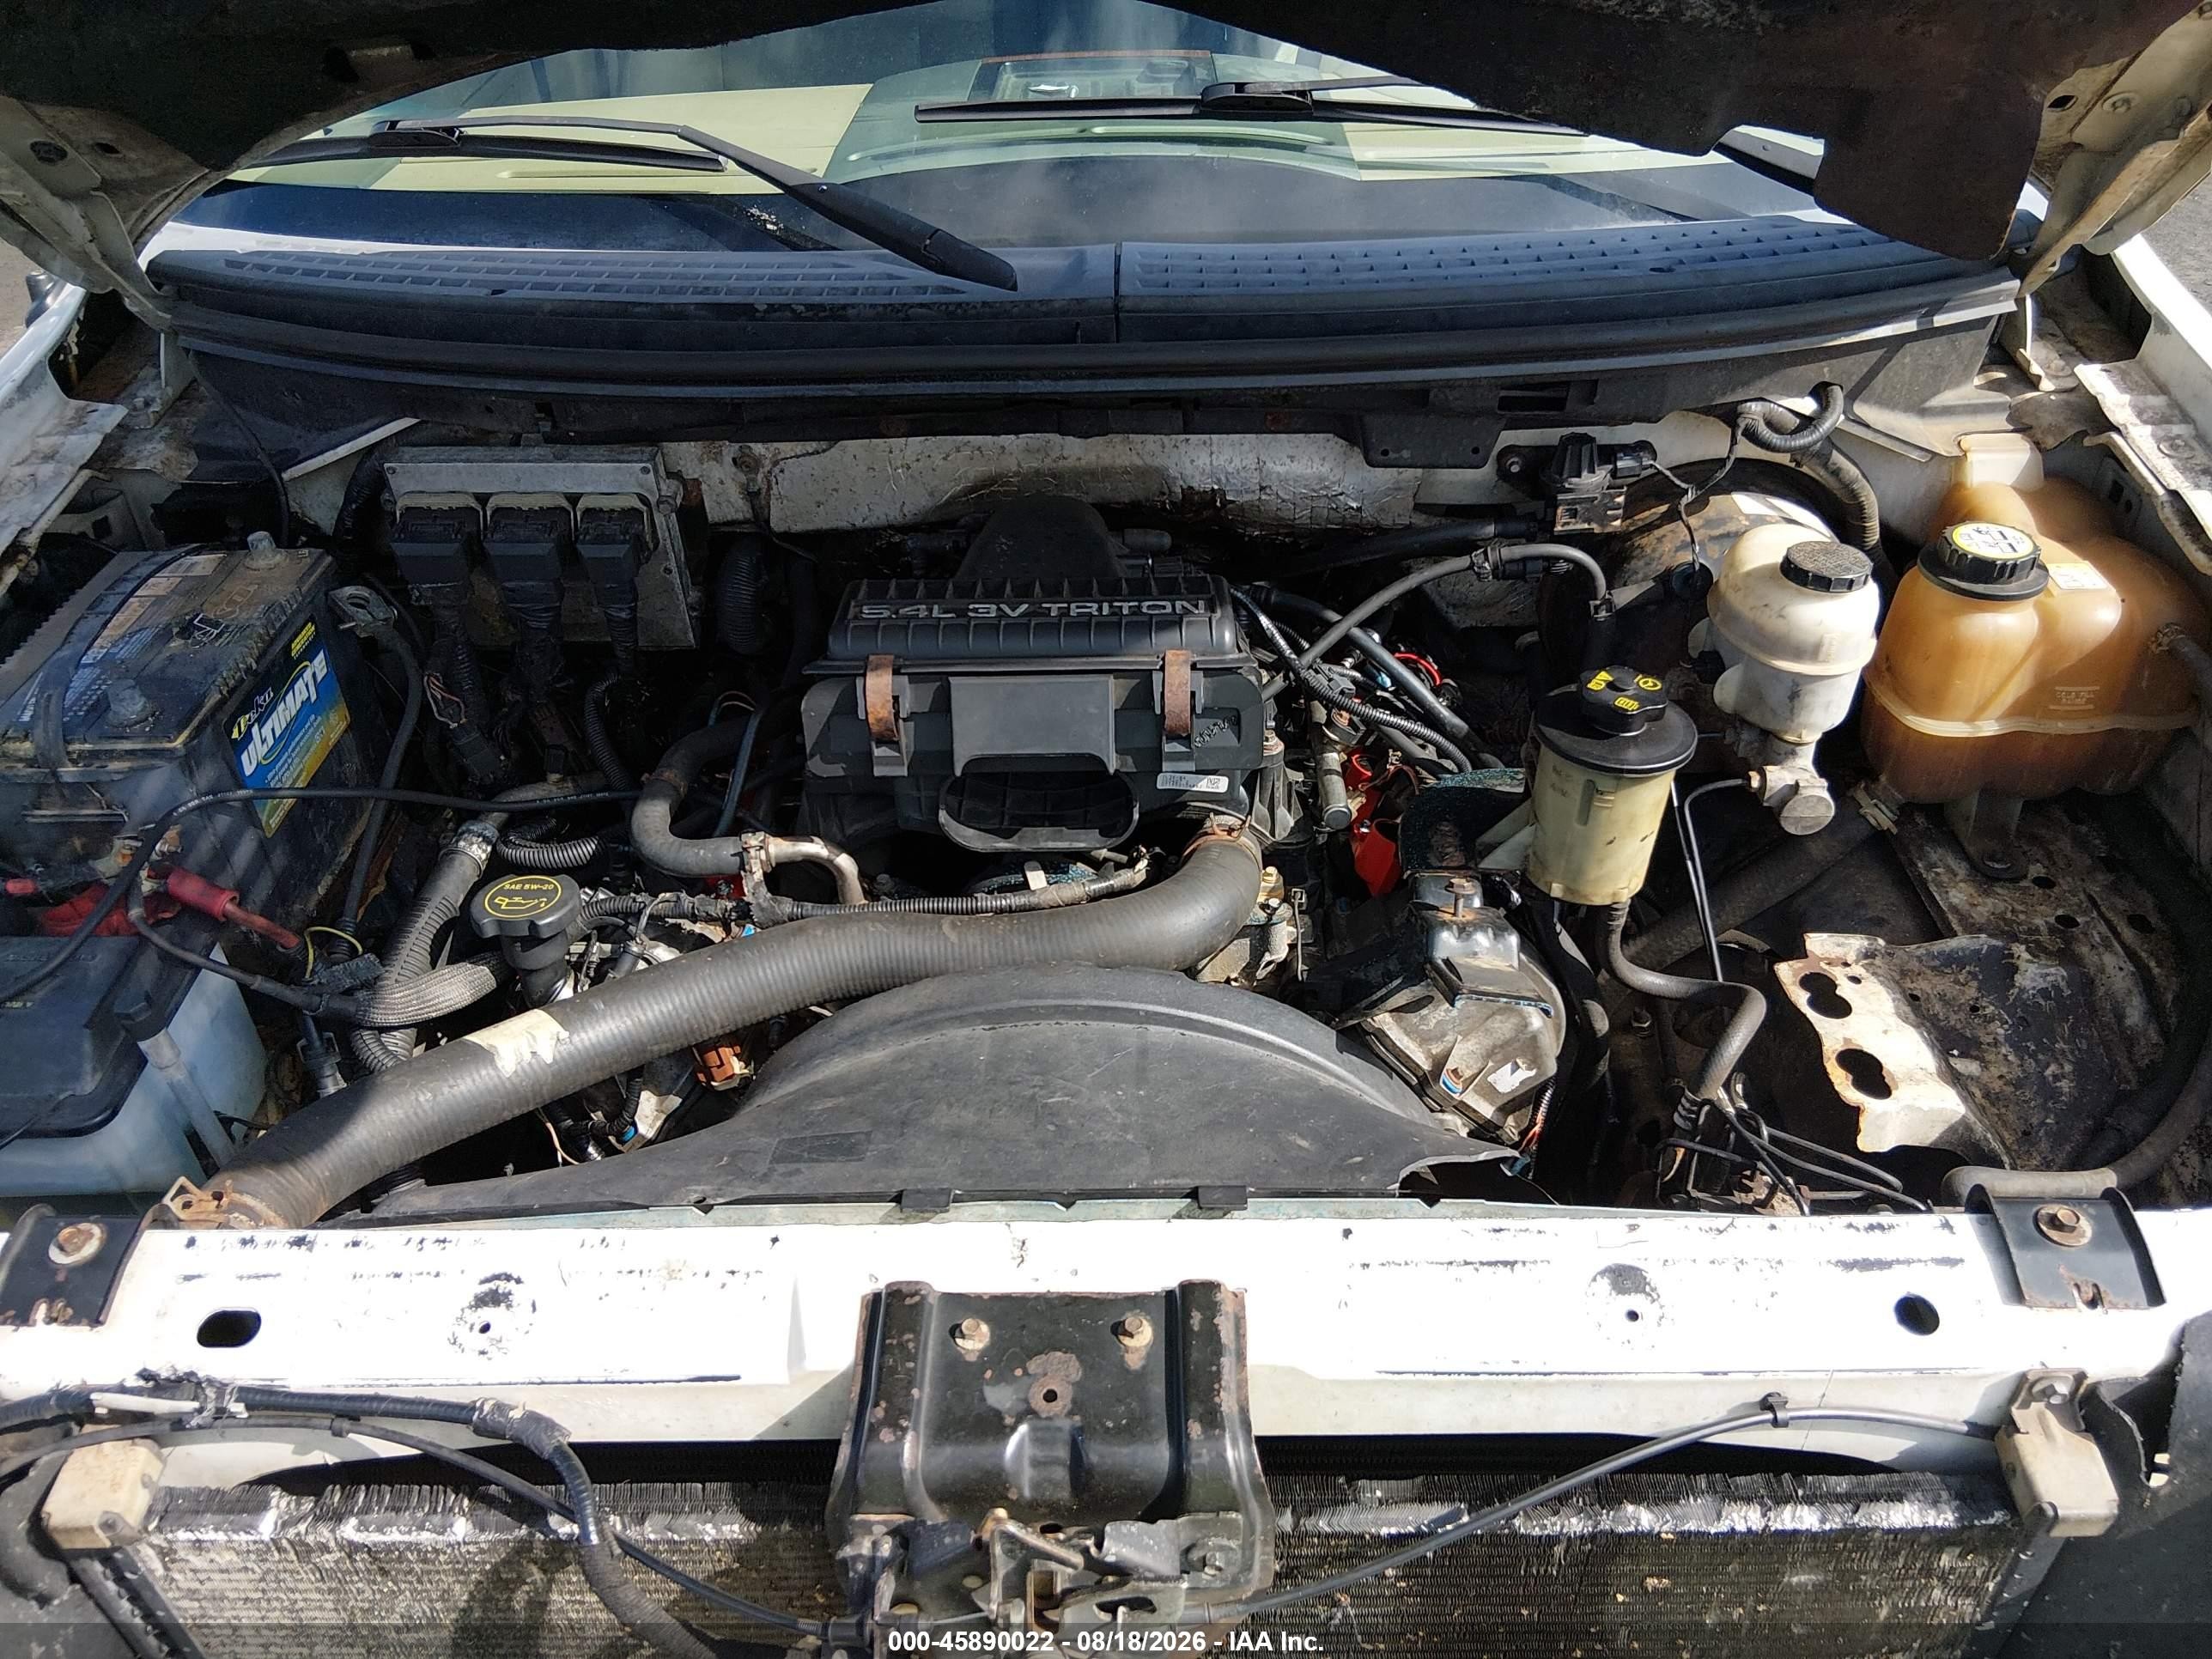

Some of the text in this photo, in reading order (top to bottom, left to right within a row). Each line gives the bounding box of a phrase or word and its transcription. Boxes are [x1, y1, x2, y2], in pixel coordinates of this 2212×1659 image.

[861, 599, 1205, 618] 5.4L 3V TRITON
[240, 648, 328, 777] ULTIMATE
